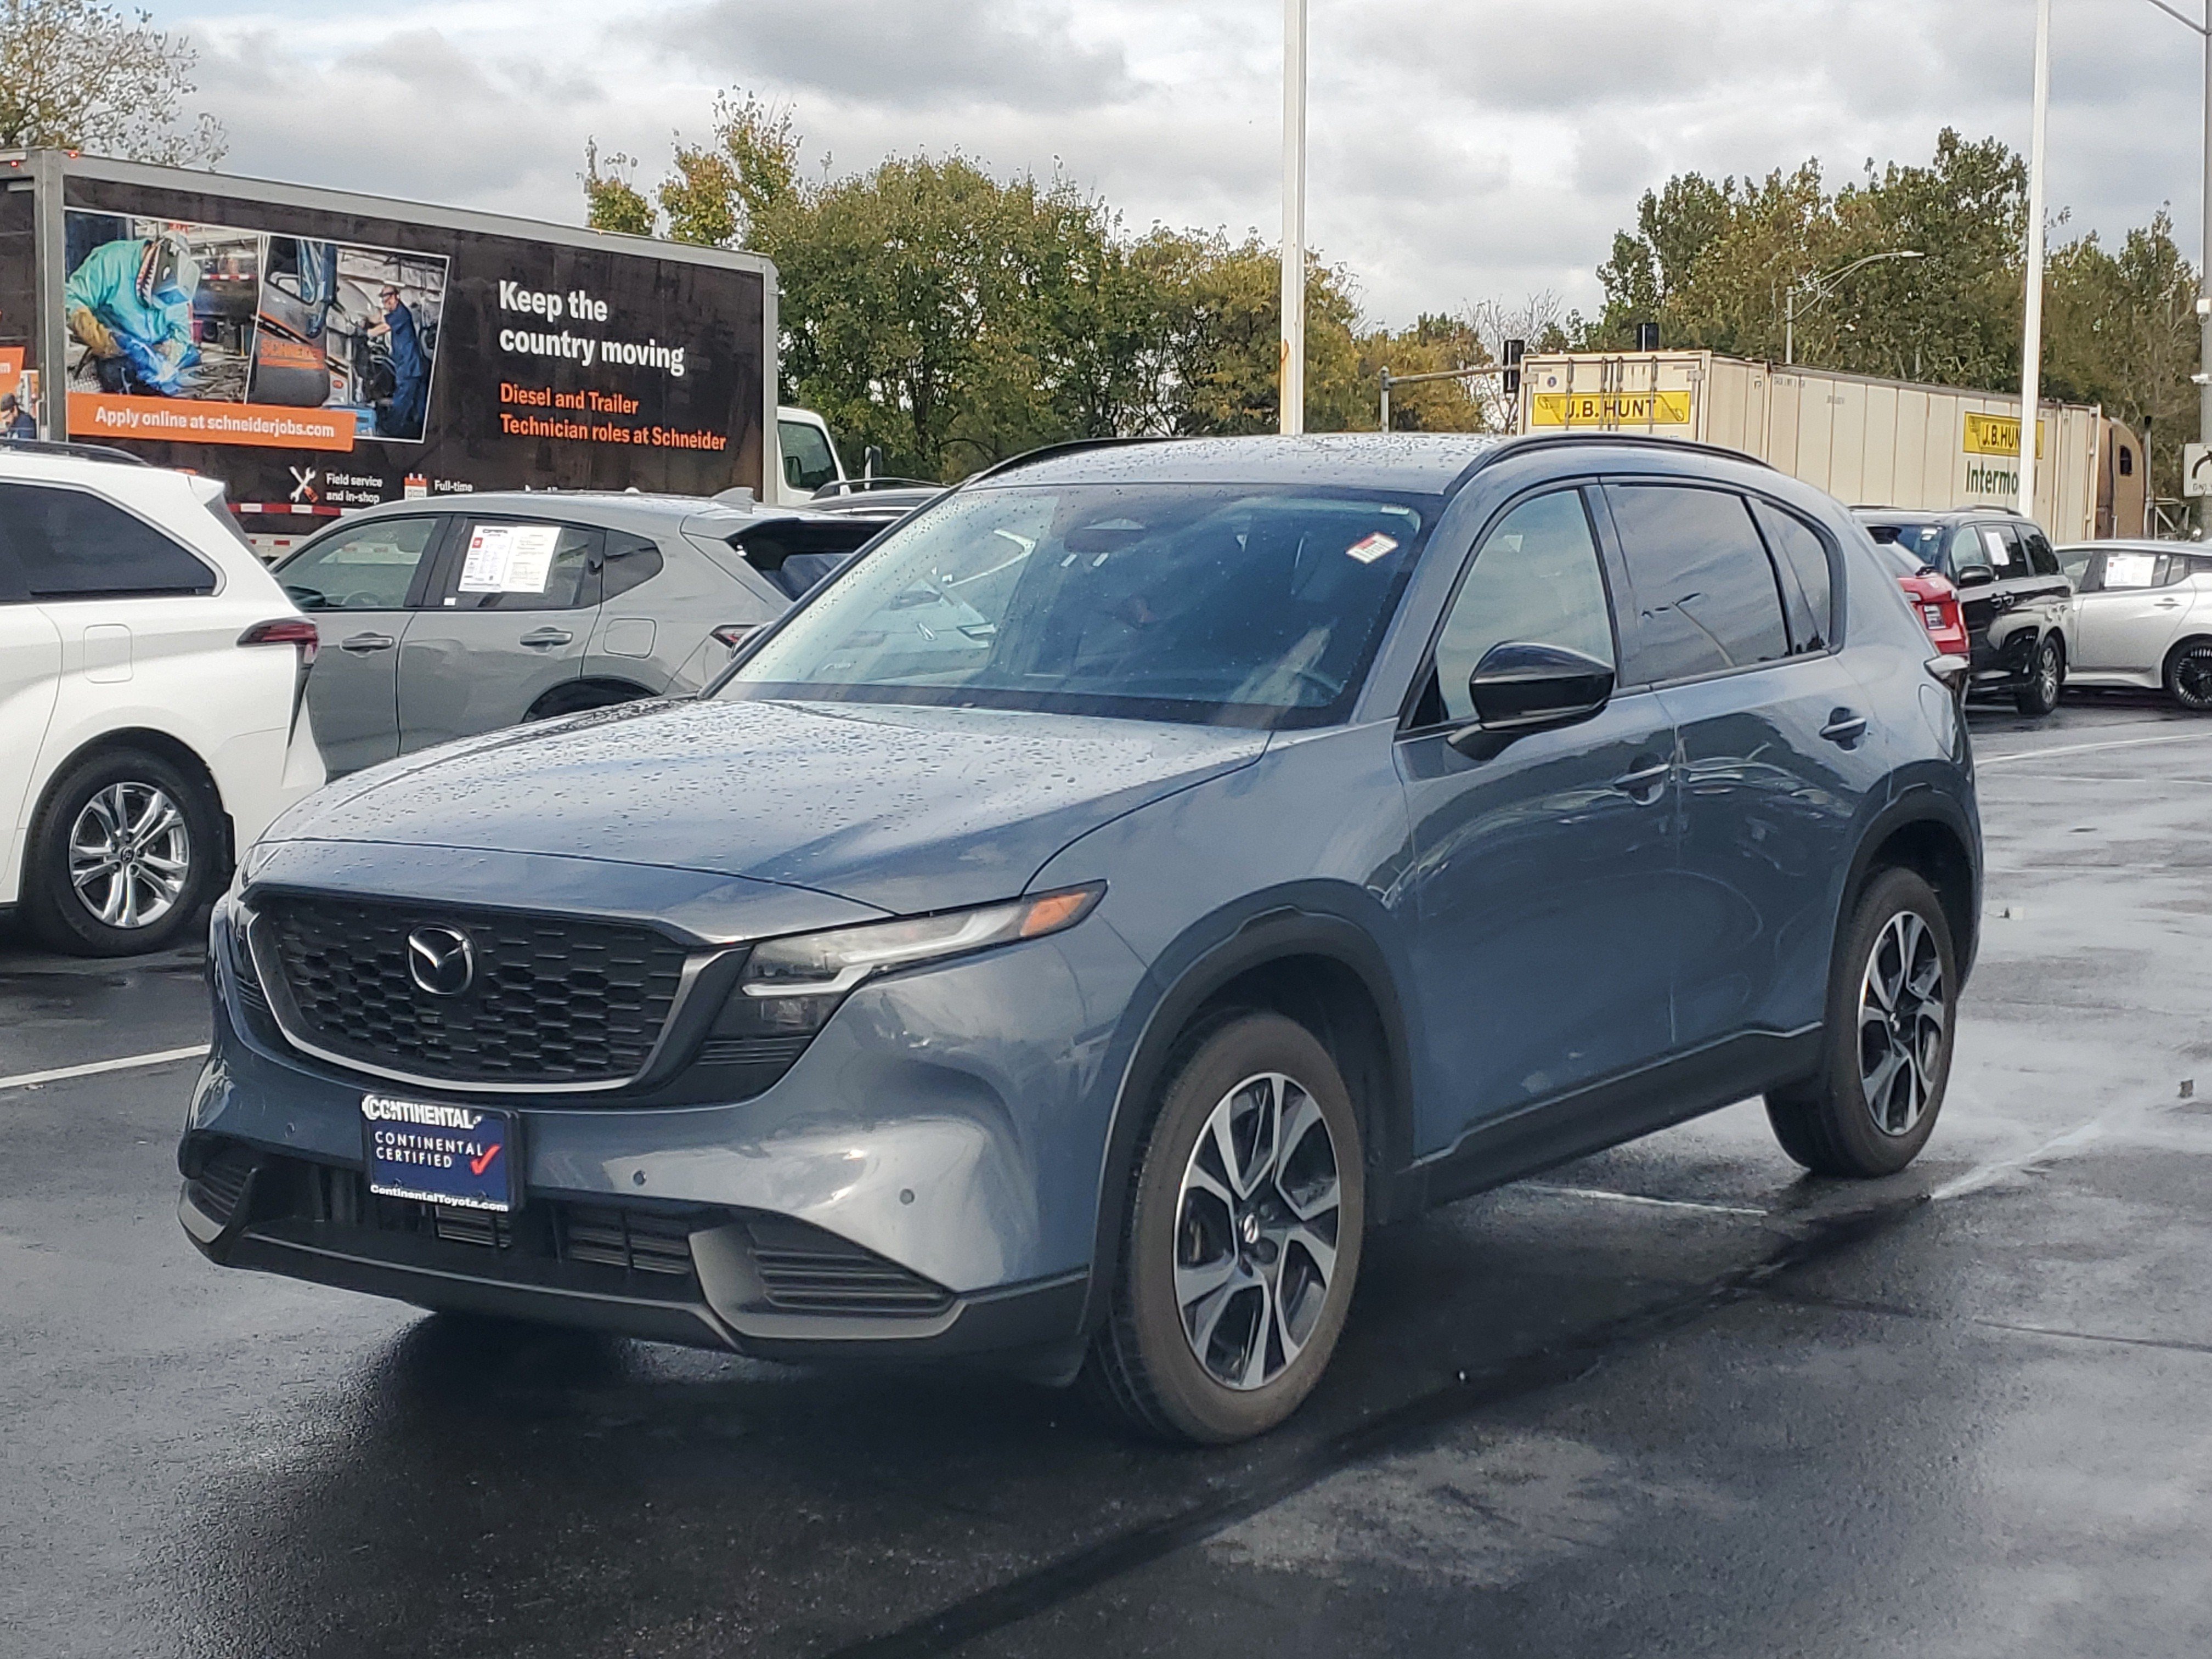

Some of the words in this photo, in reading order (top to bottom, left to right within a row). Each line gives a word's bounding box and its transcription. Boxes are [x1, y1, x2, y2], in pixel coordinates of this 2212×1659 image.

[499, 280, 562, 322] Keep
[568, 290, 608, 321] the
[499, 329, 595, 366] country
[601, 338, 685, 376] moving
[500, 383, 551, 407] Diesel
[555, 390, 585, 410] and
[588, 391, 639, 415] Trailer
[1565, 400, 1599, 418] J.B.
[1603, 399, 1656, 418] HUNT
[95, 407, 139, 428] Apply
[142, 410, 187, 428] online
[190, 415, 205, 430] at
[207, 415, 334, 437] schneiderjobs.com
[500, 413, 588, 440] Technician
[592, 422, 630, 443] roles
[633, 427, 650, 444] at
[651, 427, 727, 451] Schneider
[1983, 424, 1999, 446] J.B.
[2001, 426, 2021, 448] HUN
[326, 473, 349, 486] Field
[351, 476, 383, 488] service
[434, 480, 473, 492] Full-time
[326, 490, 344, 501] and
[346, 491, 380, 504] in-shop
[362, 1094, 475, 1130] CONTINENTAL
[375, 1131, 484, 1156] CONTINENTAL
[376, 1147, 453, 1169] CERTIFIED
[370, 1184, 509, 1212] ContinentalToyota.com
